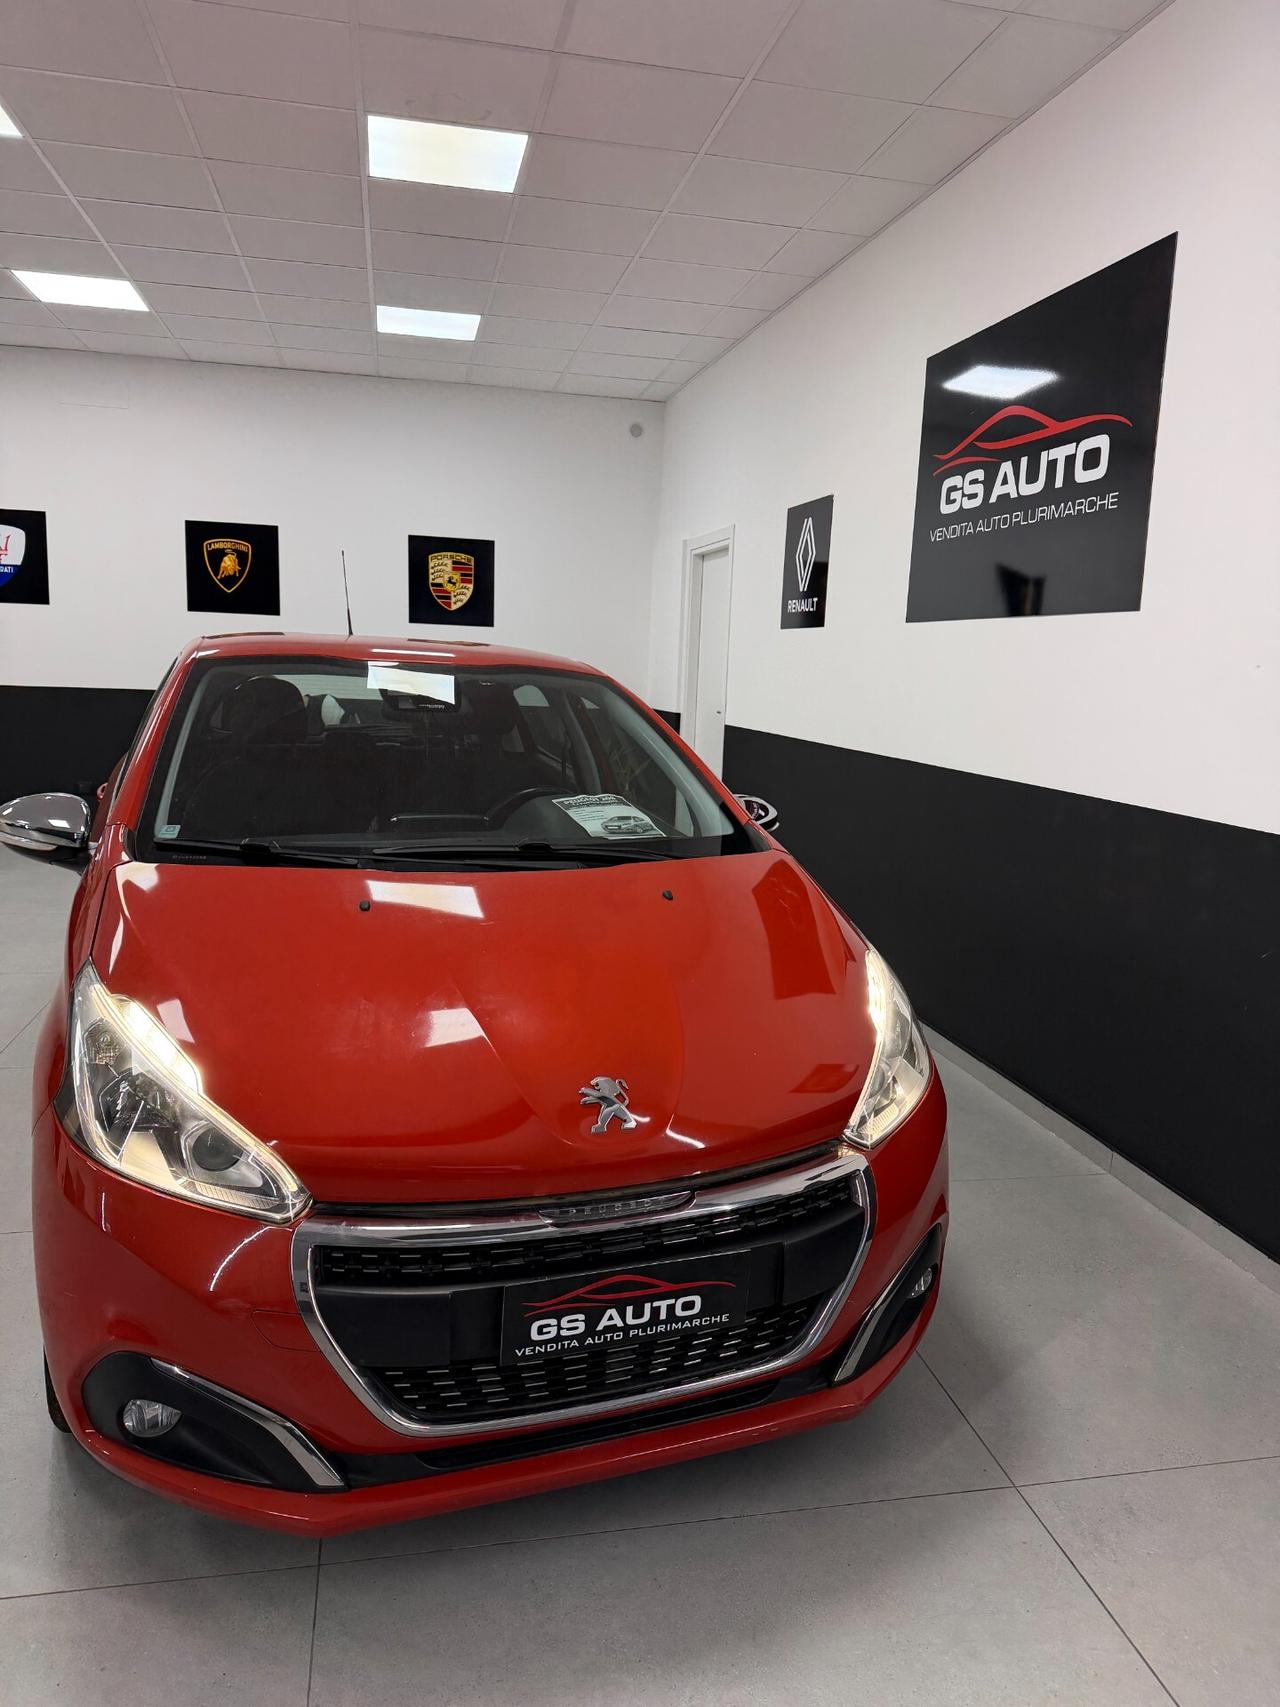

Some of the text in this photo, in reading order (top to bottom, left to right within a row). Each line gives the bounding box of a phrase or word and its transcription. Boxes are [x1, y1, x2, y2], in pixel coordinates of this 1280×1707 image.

[940, 434, 1110, 515] GS AUTO
[930, 492, 1119, 542] VENDITA AUTO PLURIMARCHE
[207, 542, 249, 552] LAMBORGHINI
[431, 553, 472, 563] PORSCHE
[787, 597, 818, 613] RENAULT
[515, 1313, 730, 1357] VENDITA AUTO PLURIMARCHE
[530, 1295, 701, 1341] GS AUTO
